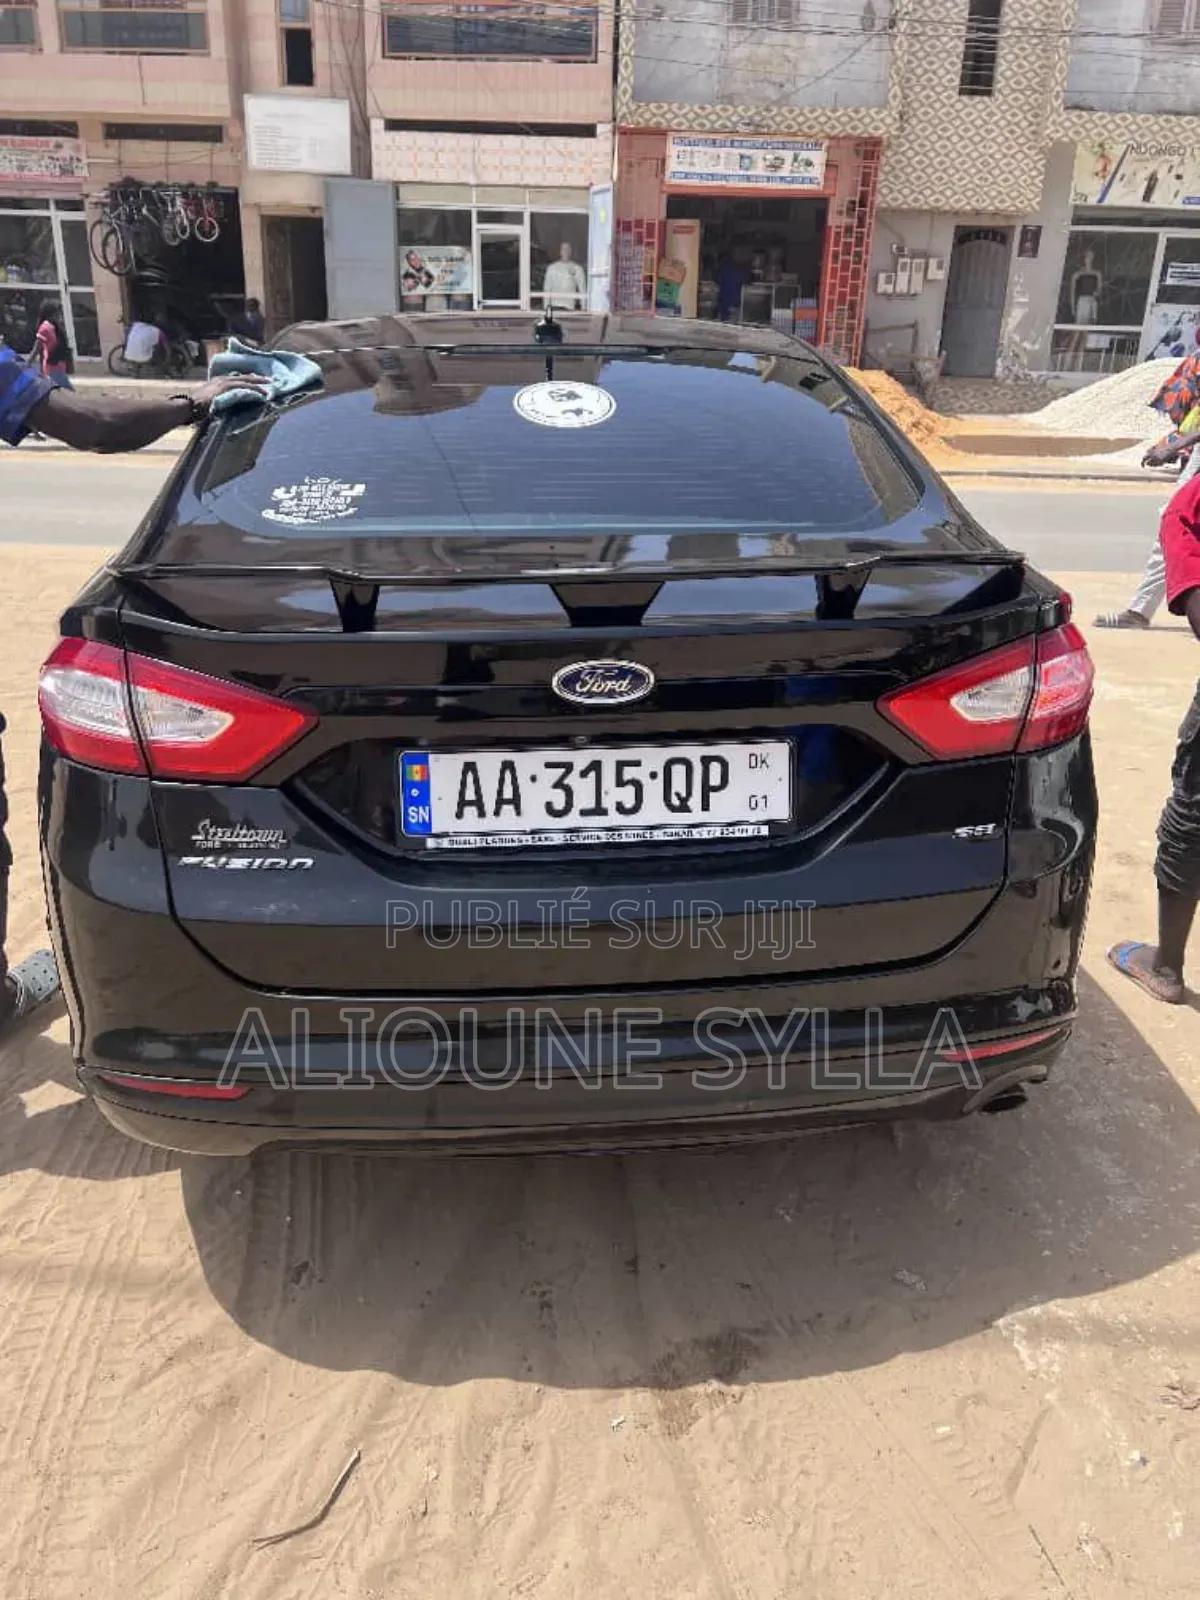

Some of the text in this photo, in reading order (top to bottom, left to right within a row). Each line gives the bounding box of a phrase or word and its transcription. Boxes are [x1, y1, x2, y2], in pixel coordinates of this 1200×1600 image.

[575, 669, 633, 692] Ford
[747, 752, 771, 770] DK
[747, 793, 770, 811] 01
[407, 805, 429, 824] SN
[178, 856, 314, 869] FUSION
